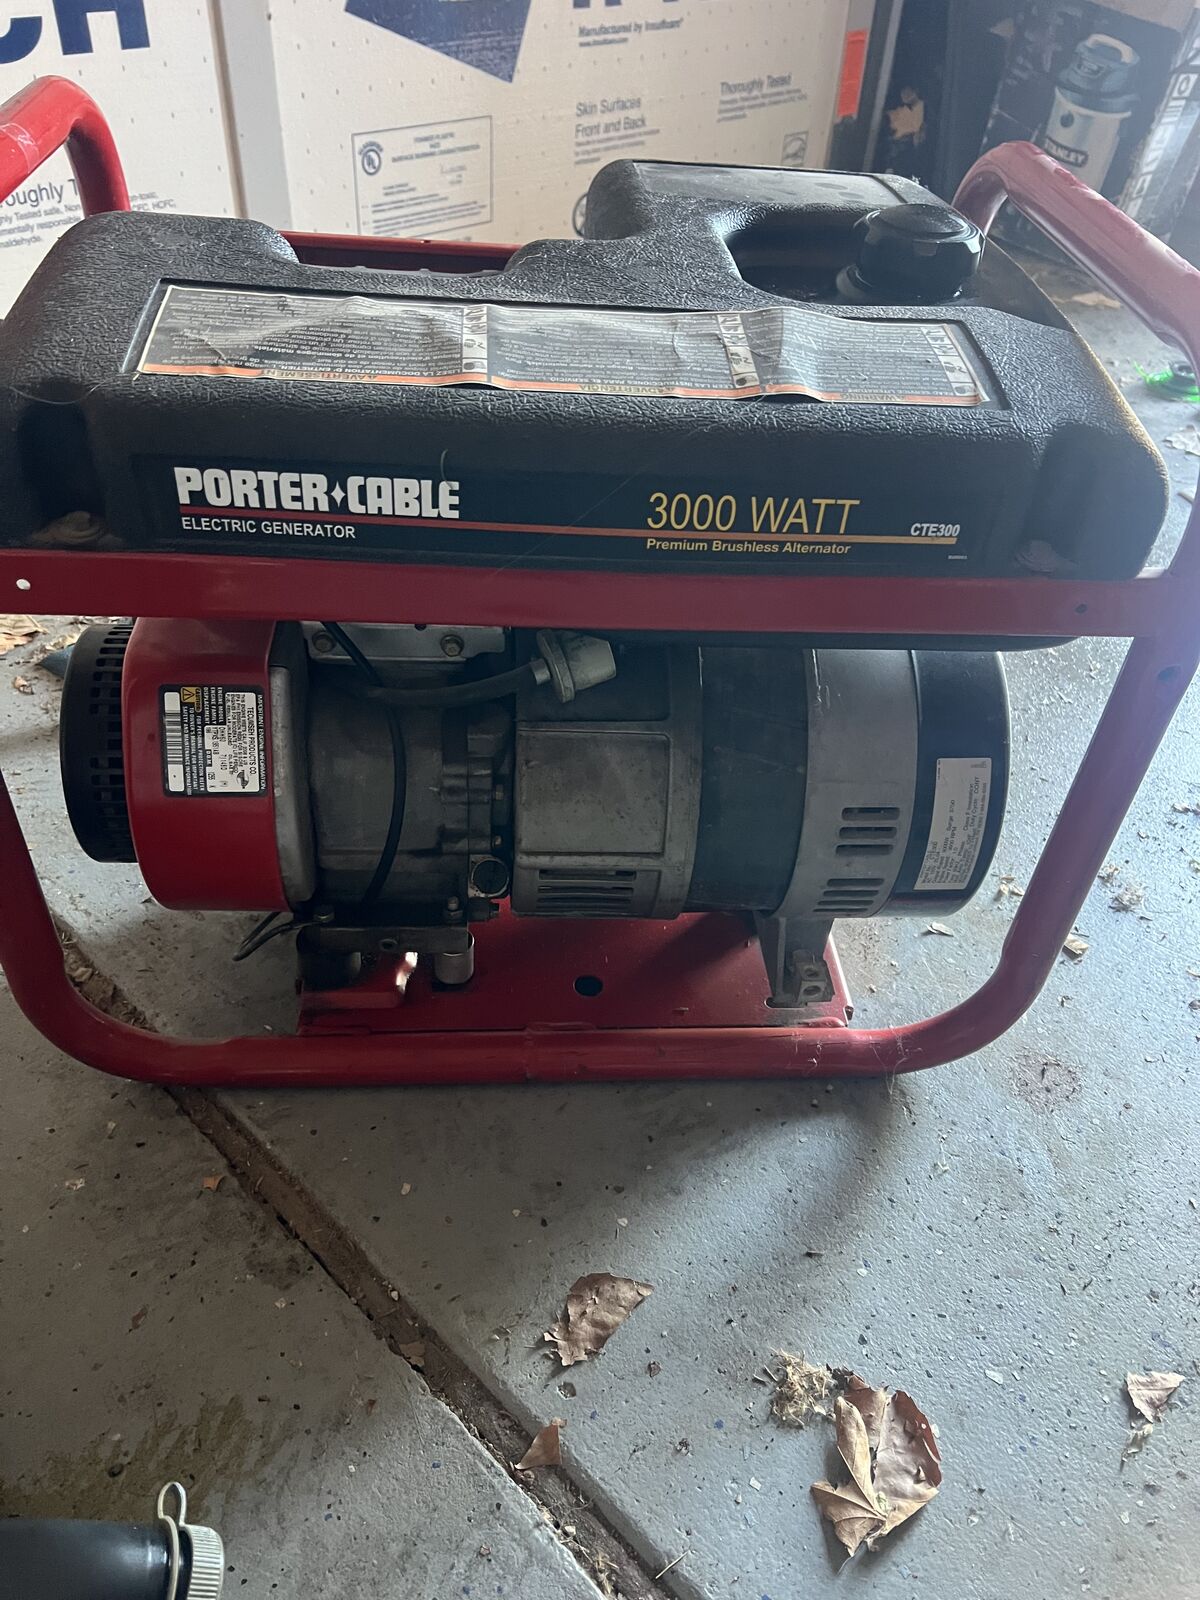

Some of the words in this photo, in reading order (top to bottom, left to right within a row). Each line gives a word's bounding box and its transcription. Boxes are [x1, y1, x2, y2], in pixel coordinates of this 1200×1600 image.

[576, 101, 598, 118] Skin
[600, 97, 641, 114] Surfaces
[575, 123, 600, 139] Front
[603, 118, 620, 134] and
[624, 114, 646, 131] Back
[1044, 138, 1085, 164] TANLEY
[5, 182, 63, 207] oughly
[291, 334, 330, 342] protecteur
[578, 385, 663, 393] ADVERTENCIA
[174, 466, 329, 512] PORTER
[347, 476, 460, 518] CABLE
[647, 492, 737, 532] 3000
[751, 496, 860, 534] WATT
[182, 517, 256, 533] ELECTRIC
[262, 521, 356, 538] GENERATOR
[910, 523, 960, 538] CTE300
[646, 538, 708, 552] Premium
[712, 540, 780, 553] Brushless
[782, 542, 851, 554] Alternator
[247, 707, 255, 736] TECUMSEH
[248, 737, 256, 765] PRODUCTS
